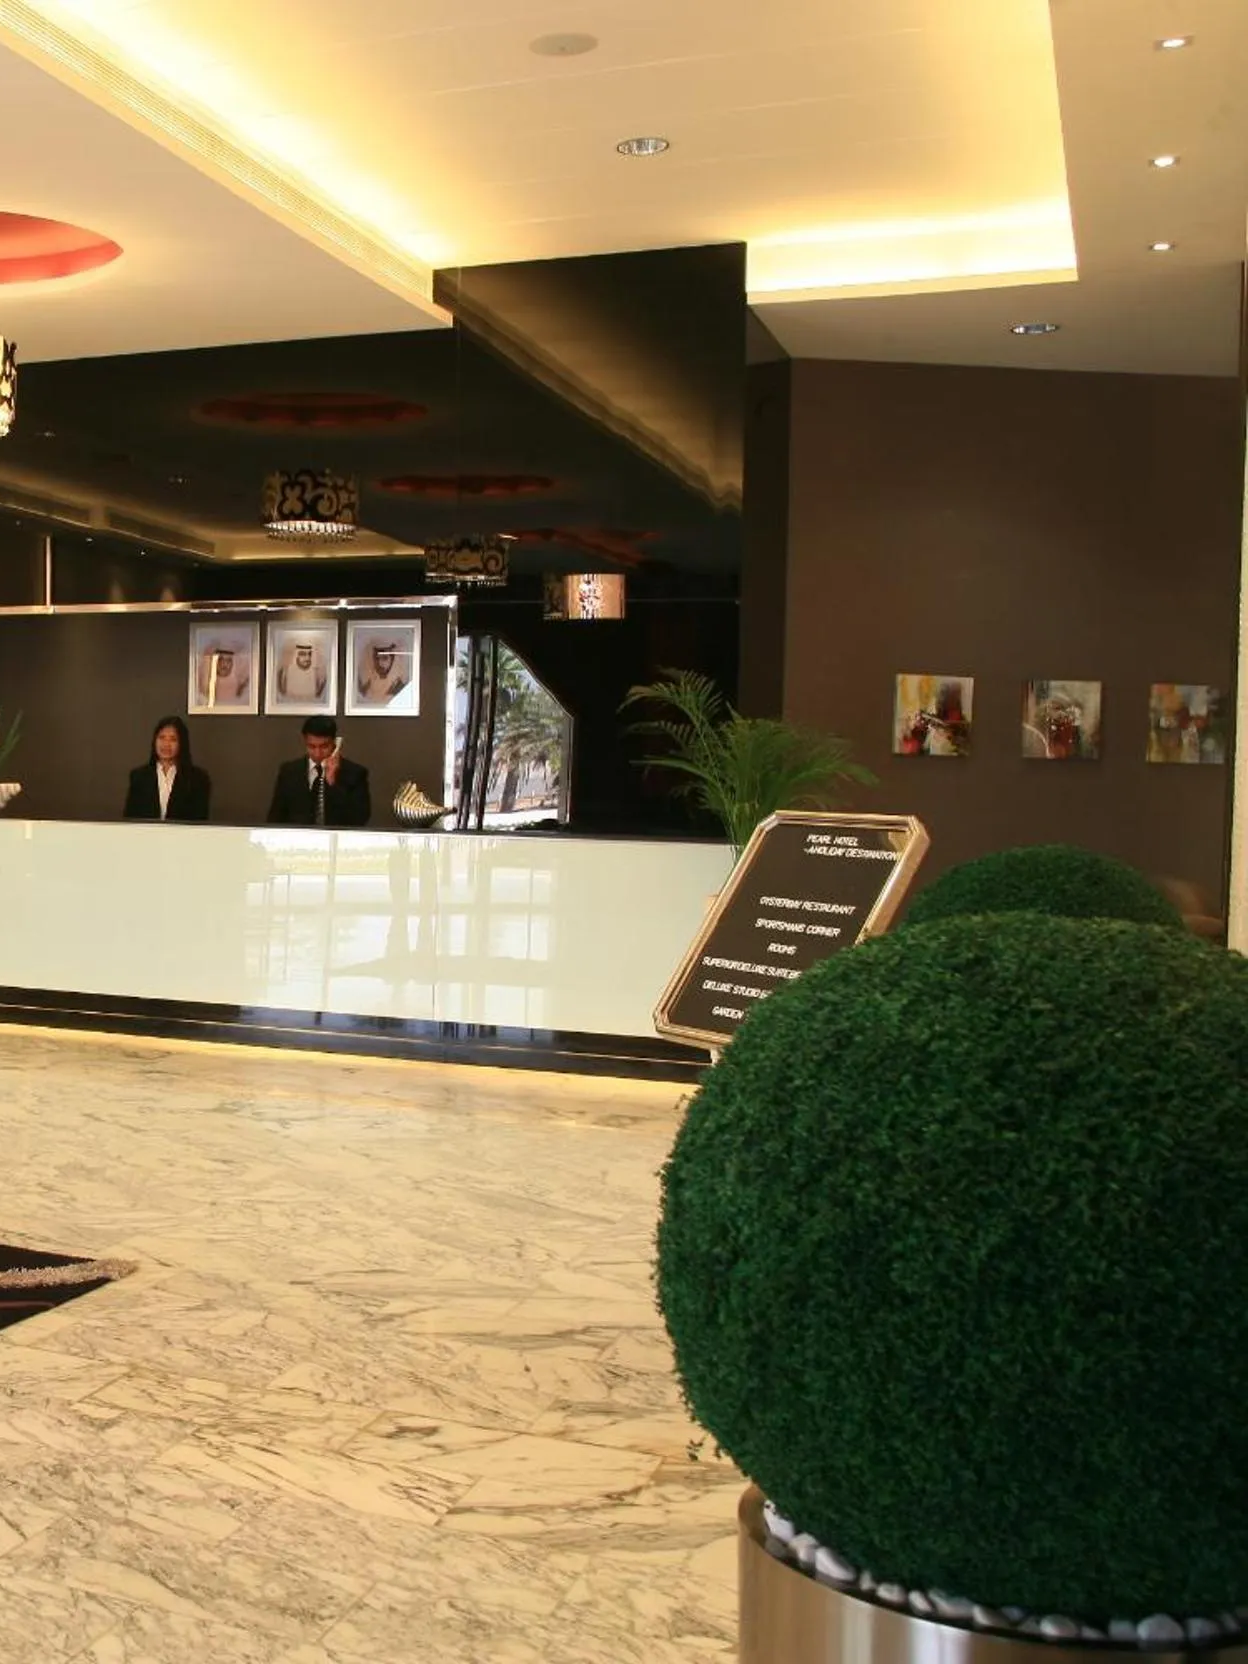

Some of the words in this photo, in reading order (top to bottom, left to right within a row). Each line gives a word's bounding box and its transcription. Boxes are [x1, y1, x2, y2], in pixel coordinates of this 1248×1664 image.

[807, 834, 832, 845] PEARL
[833, 836, 859, 847] HOTEL
[845, 848, 899, 861] DESTINATION
[802, 901, 857, 916] RESTAURANT
[806, 924, 842, 938] CORNER
[767, 943, 798, 956] ROOMS
[702, 980, 735, 993] DELUXE
[732, 984, 761, 998] STUDIO
[712, 1006, 745, 1020] GARDEN
